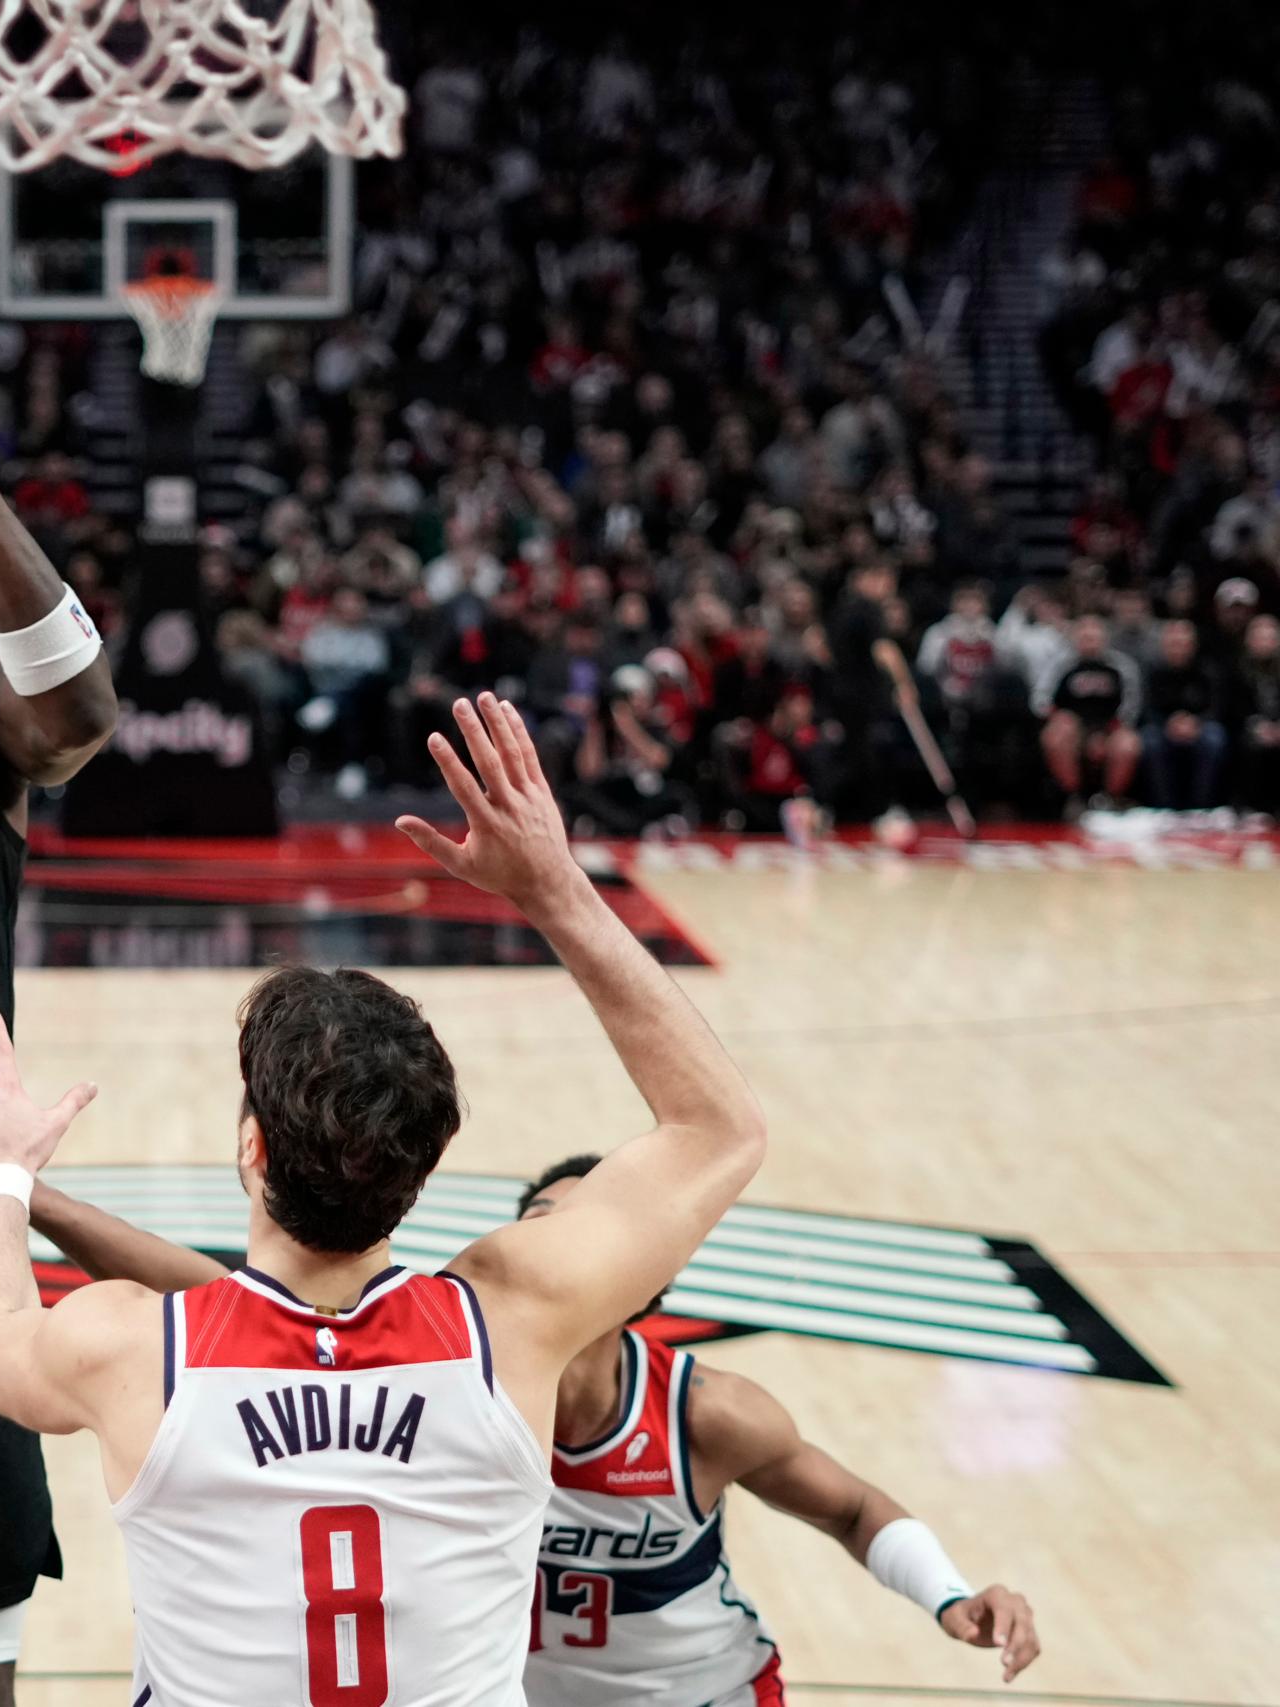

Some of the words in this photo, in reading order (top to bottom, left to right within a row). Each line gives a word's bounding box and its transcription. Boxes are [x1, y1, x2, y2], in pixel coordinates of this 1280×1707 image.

[111, 698, 253, 767] ipcity
[236, 1383, 426, 1468] AVDIJA
[607, 1468, 670, 1484] Robinhood
[300, 1503, 389, 1707] 8
